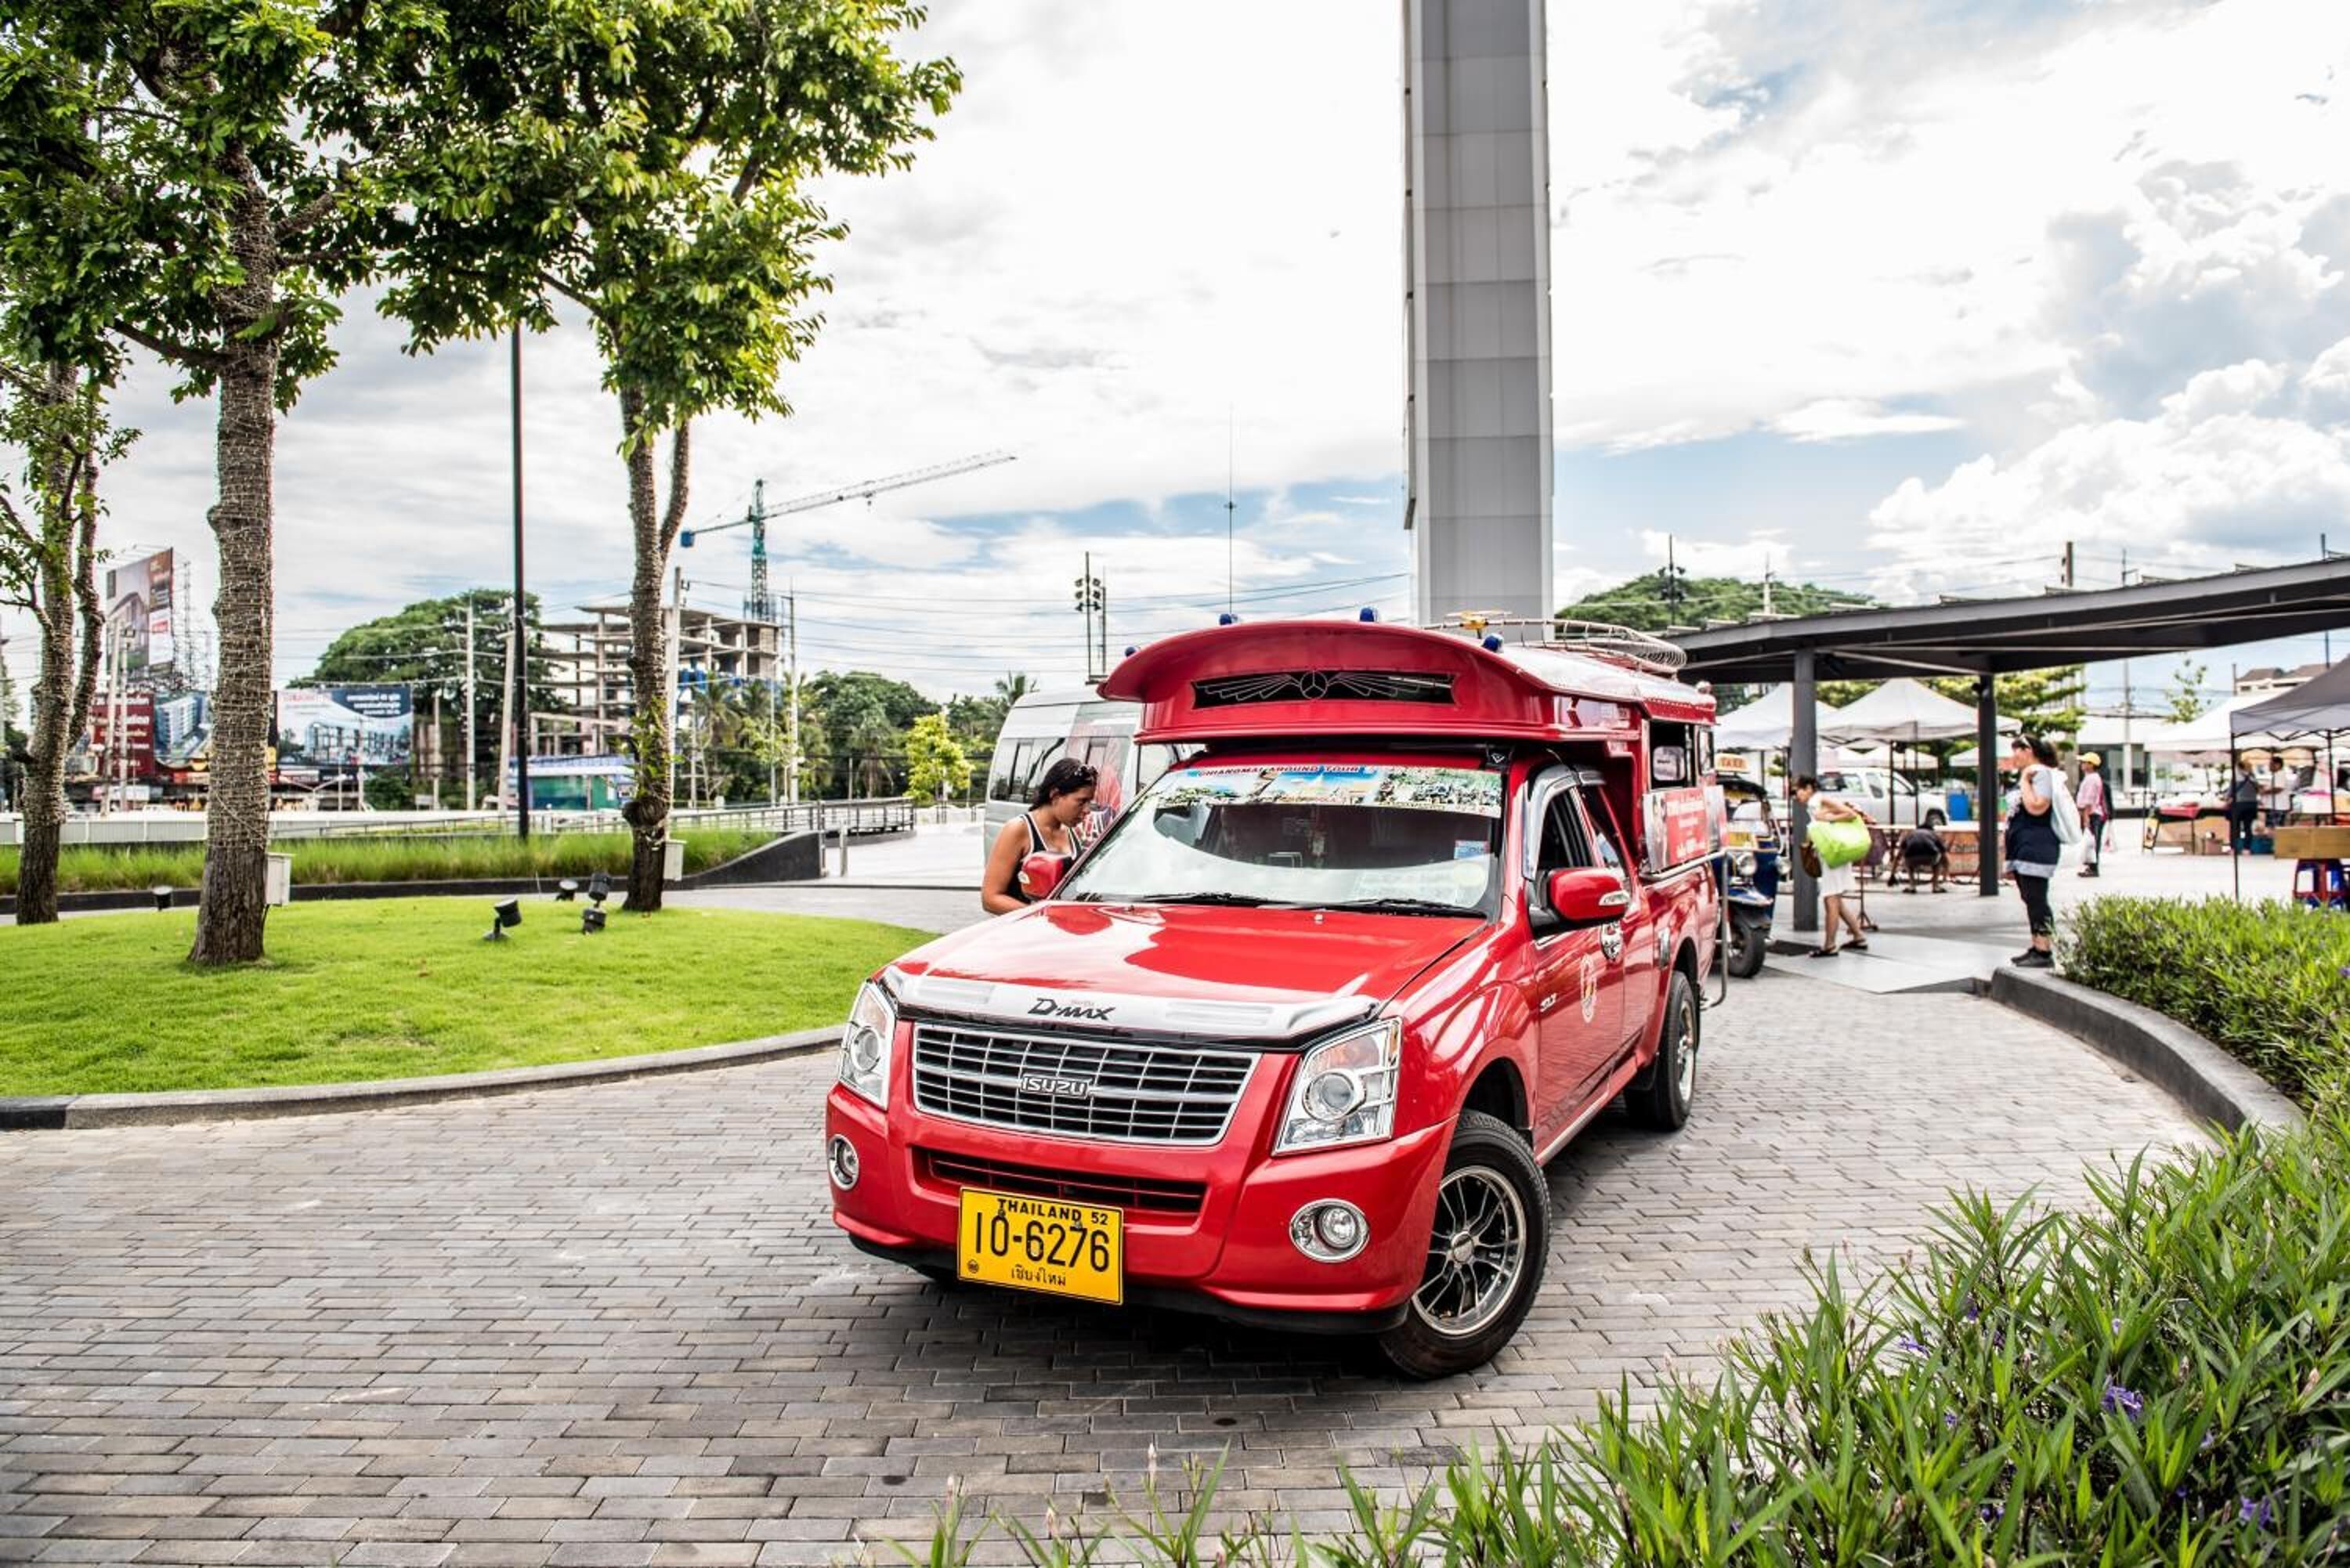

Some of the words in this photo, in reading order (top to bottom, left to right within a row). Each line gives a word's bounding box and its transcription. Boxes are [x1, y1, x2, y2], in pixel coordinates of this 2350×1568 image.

[1021, 1076, 1086, 1096] ISUZU
[997, 1198, 1082, 1221] THAILAND
[1091, 1212, 1108, 1225] 52
[976, 1212, 1109, 1273] 10-6276
